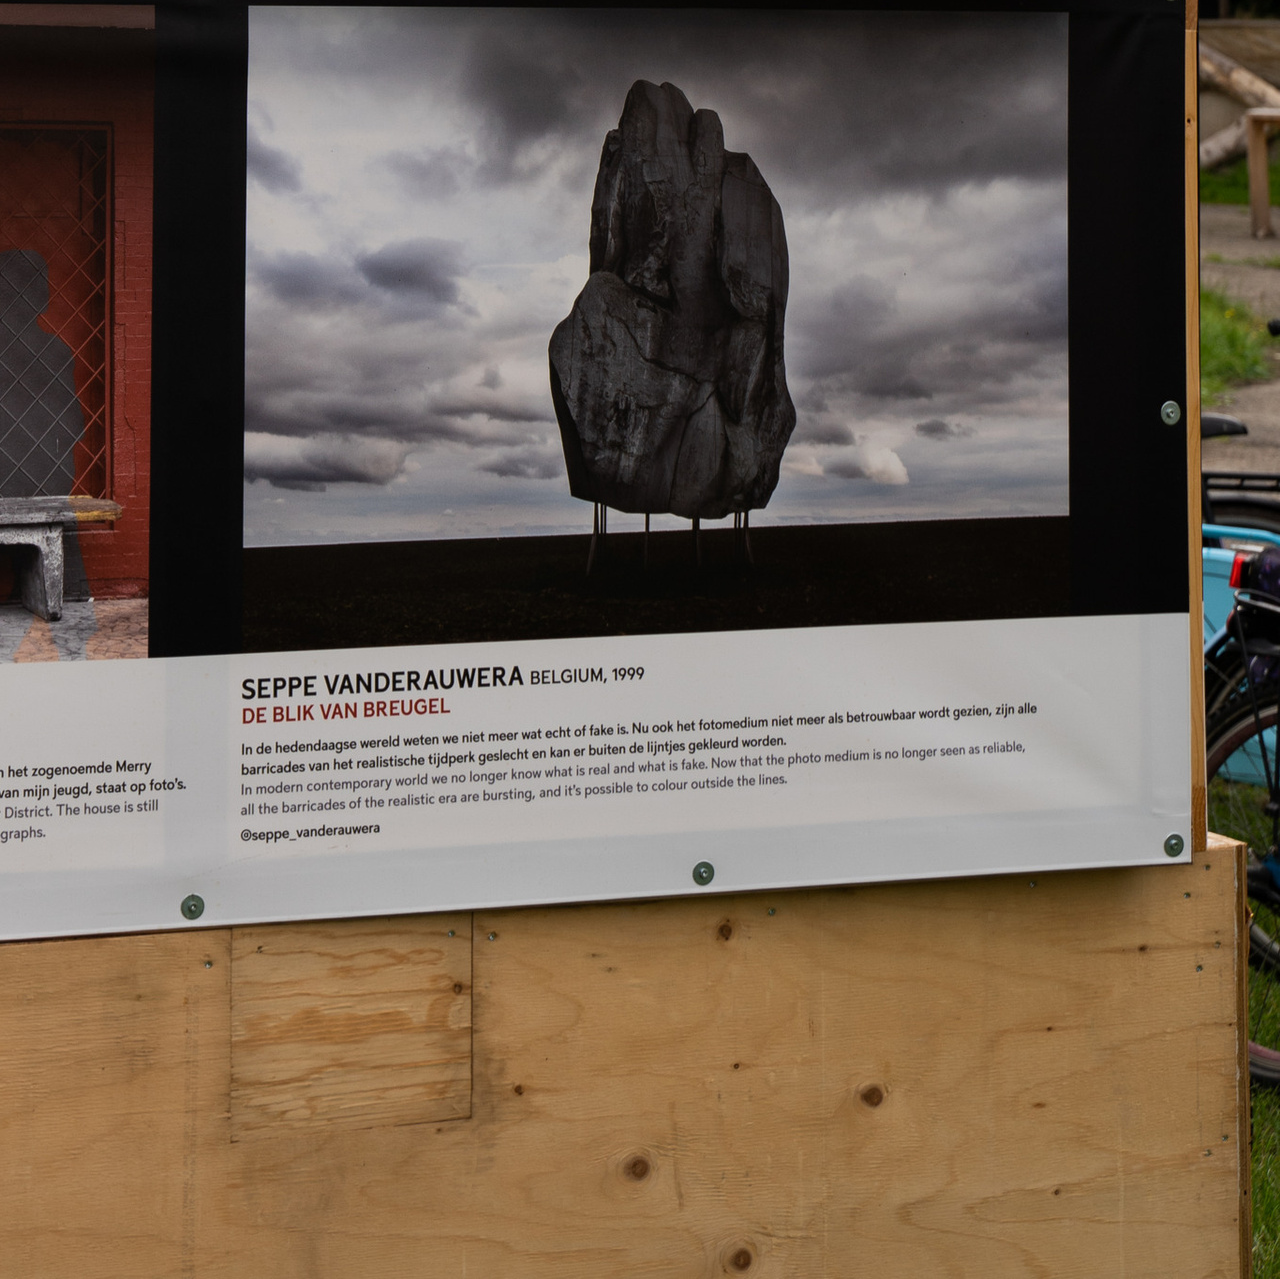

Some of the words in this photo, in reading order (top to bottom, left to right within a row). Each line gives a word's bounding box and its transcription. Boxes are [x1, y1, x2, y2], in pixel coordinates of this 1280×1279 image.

[241, 675, 317, 701] SEPPE
[323, 665, 524, 696] VANDERAUWERA
[530, 667, 608, 686] BELGIUM,
[611, 666, 645, 682] 1999
[242, 706, 267, 725] DE
[272, 704, 315, 723] BLIK
[319, 701, 358, 721] VAN
[363, 697, 451, 718] BREUGEL
[241, 760, 306, 776] barricades
[308, 761, 330, 772] van
[332, 758, 354, 771] het
[356, 753, 426, 770] realistische
[427, 750, 476, 769] tijdperk
[477, 747, 529, 766] geslecht
[531, 750, 547, 760] en
[549, 746, 571, 759] kan
[573, 747, 586, 757] er
[588, 743, 626, 757] buiten
[628, 741, 645, 754] de
[646, 740, 686, 757] lijntjes
[687, 736, 739, 755] gekleurd
[741, 734, 787, 748] worden.
[240, 824, 381, 844] @seppe_vanderauwera
